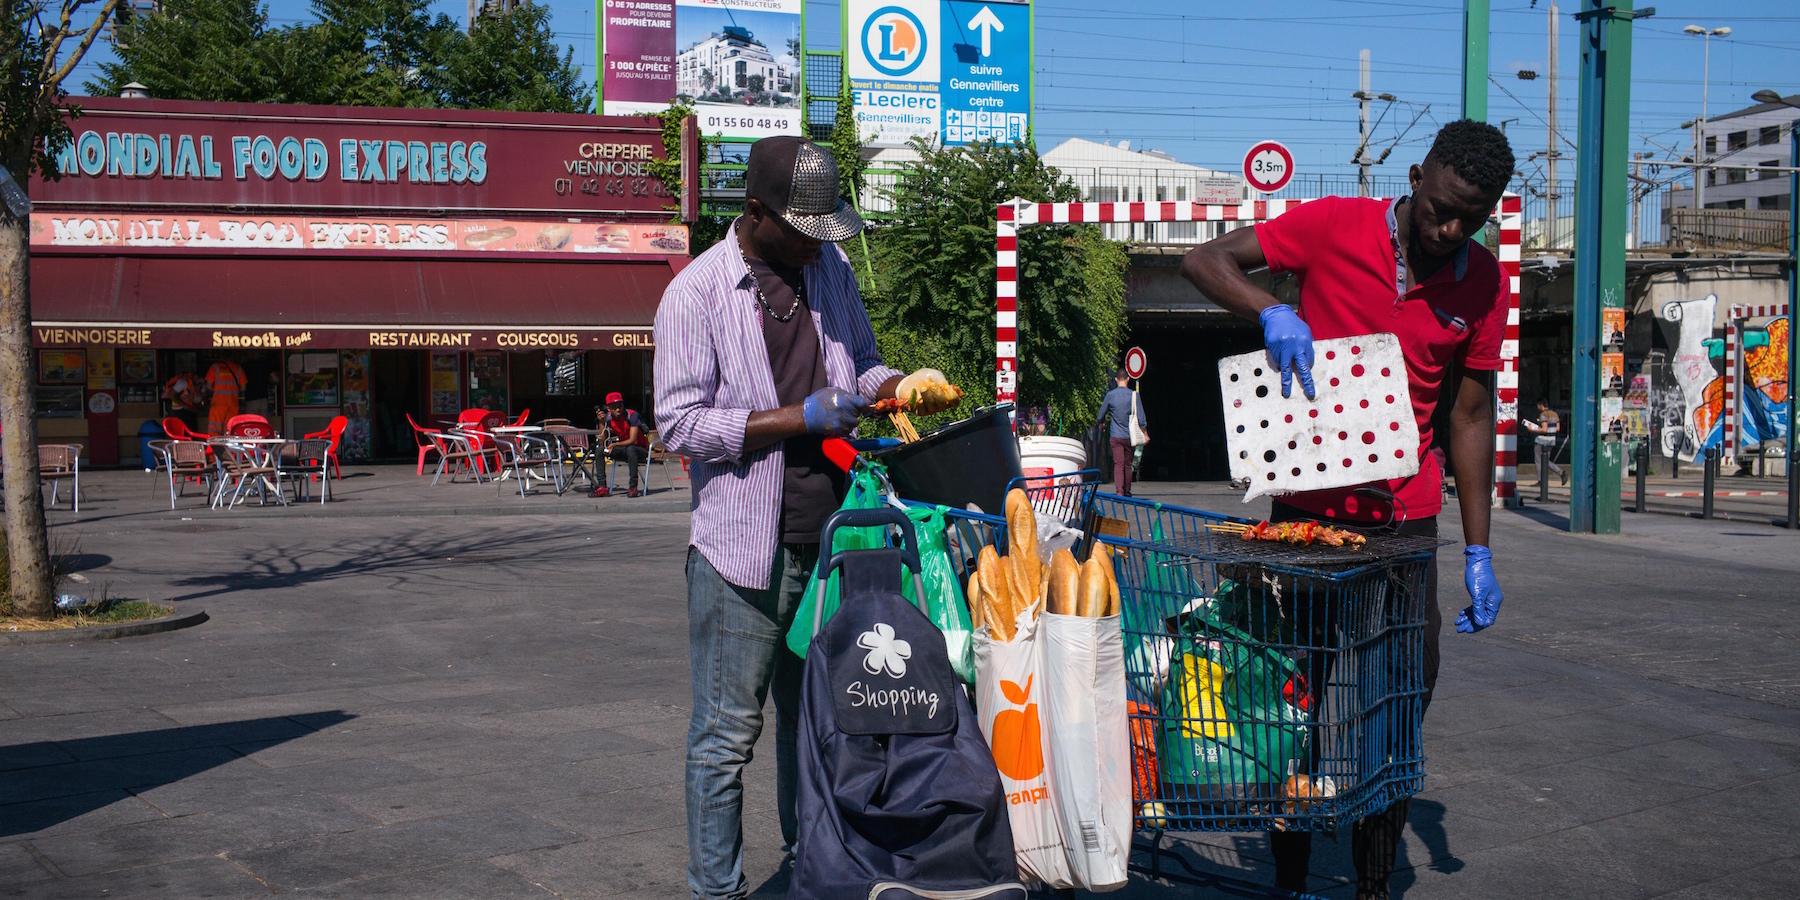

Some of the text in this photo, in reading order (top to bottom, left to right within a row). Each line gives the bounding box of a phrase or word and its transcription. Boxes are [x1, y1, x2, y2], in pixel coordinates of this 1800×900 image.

[615, 1, 625, 9] DE
[635, 2, 672, 11] ADRESSES
[610, 17, 672, 28] PROPRIÉTAIRE
[610, 61, 616, 70] 3
[617, 62, 634, 70] 000
[970, 64, 1003, 75] suivre
[874, 81, 882, 89] le
[883, 82, 917, 91] dimanche
[949, 78, 1019, 92] Gennevilliers
[852, 91, 937, 109] E.Leclerc
[969, 97, 1004, 107] centre
[708, 116, 788, 130] 01 55 60 48 49
[579, 142, 654, 159] CREPERIE
[232, 134, 329, 181] FOOD
[340, 138, 488, 184] EXPRESS
[1255, 160, 1283, 173] 3,5m
[555, 178, 572, 193] 01
[51, 218, 450, 245] MONDIAL FOOD EXPRESS
[39, 329, 151, 345] VIENNOISERIE
[212, 331, 281, 347] Smooth
[369, 332, 472, 346] RESTAURANT
[497, 333, 579, 347] COUSCOUS
[847, 681, 940, 719] Shopping
